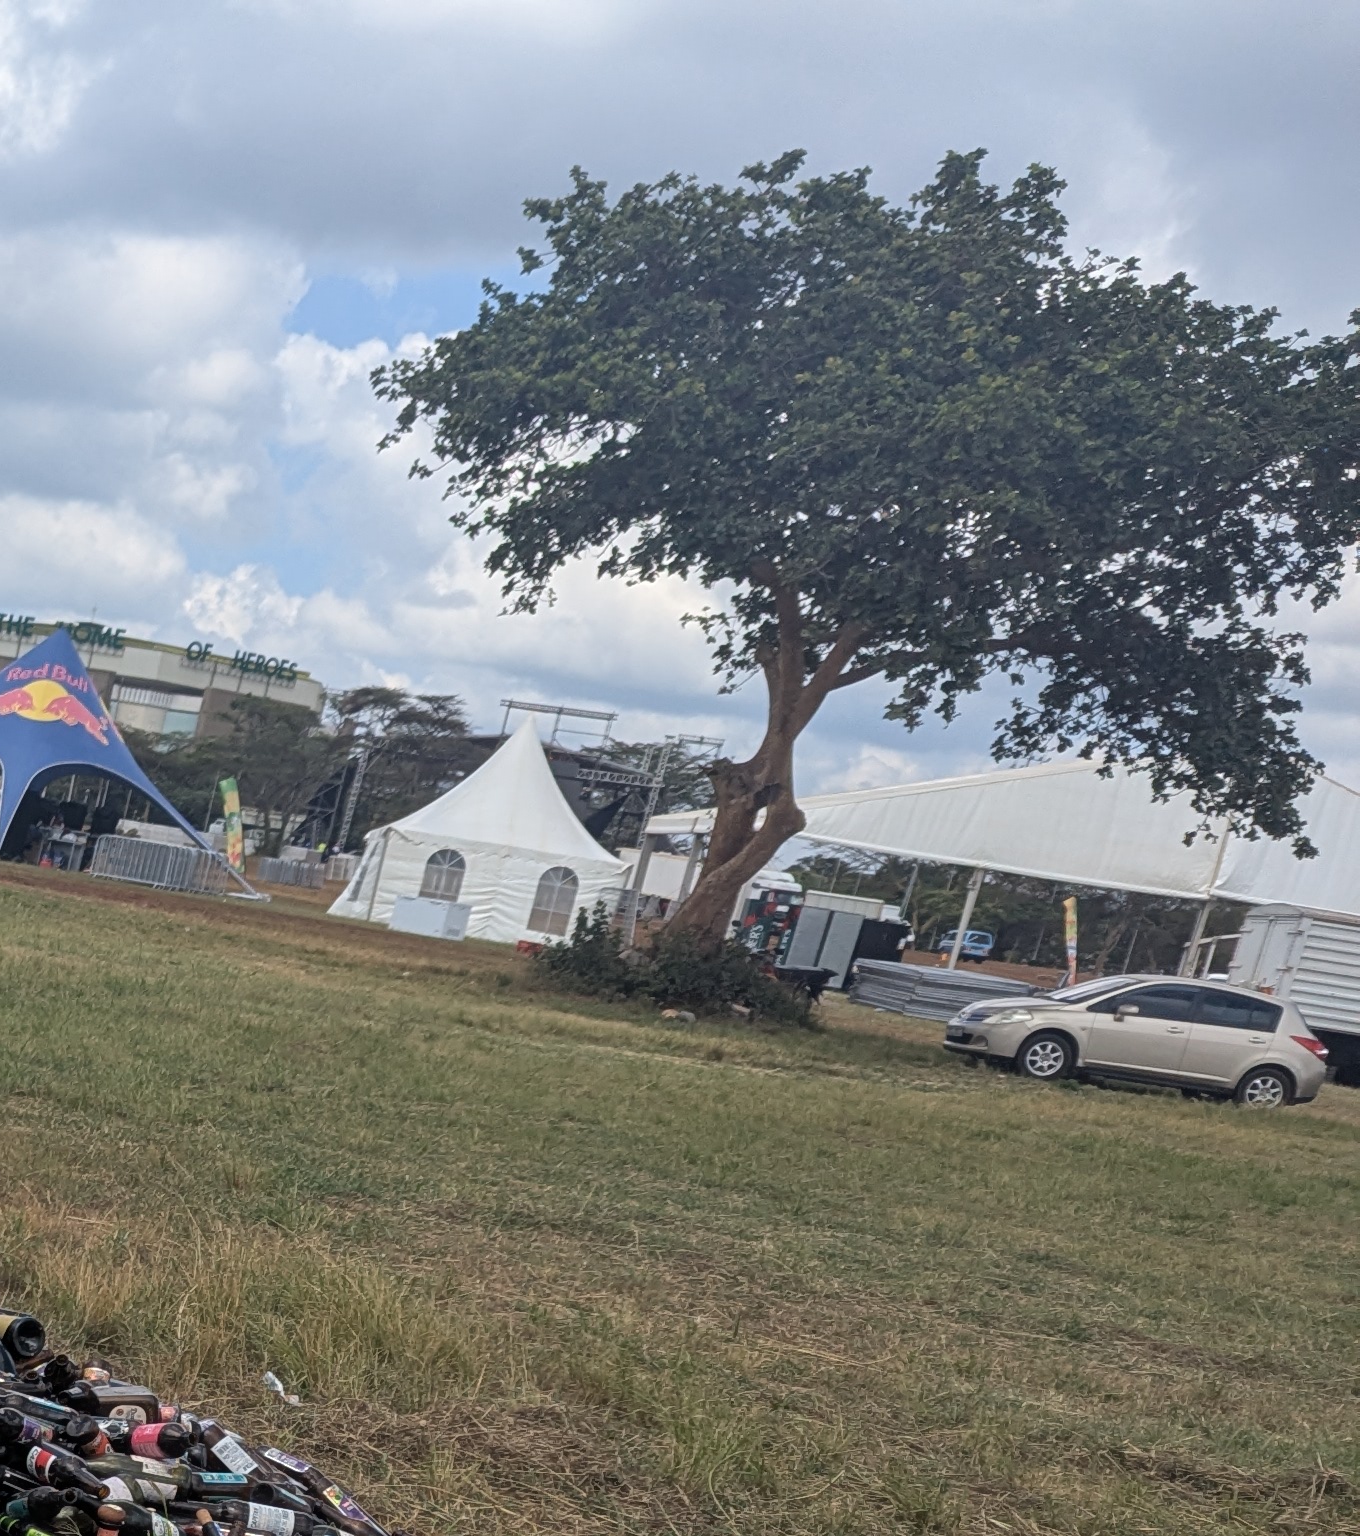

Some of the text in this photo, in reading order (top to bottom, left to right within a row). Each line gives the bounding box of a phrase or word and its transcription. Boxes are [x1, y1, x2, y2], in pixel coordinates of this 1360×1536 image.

[186, 641, 214, 662] OF
[231, 650, 299, 680] HEROES
[6, 663, 88, 693] Red Bull
